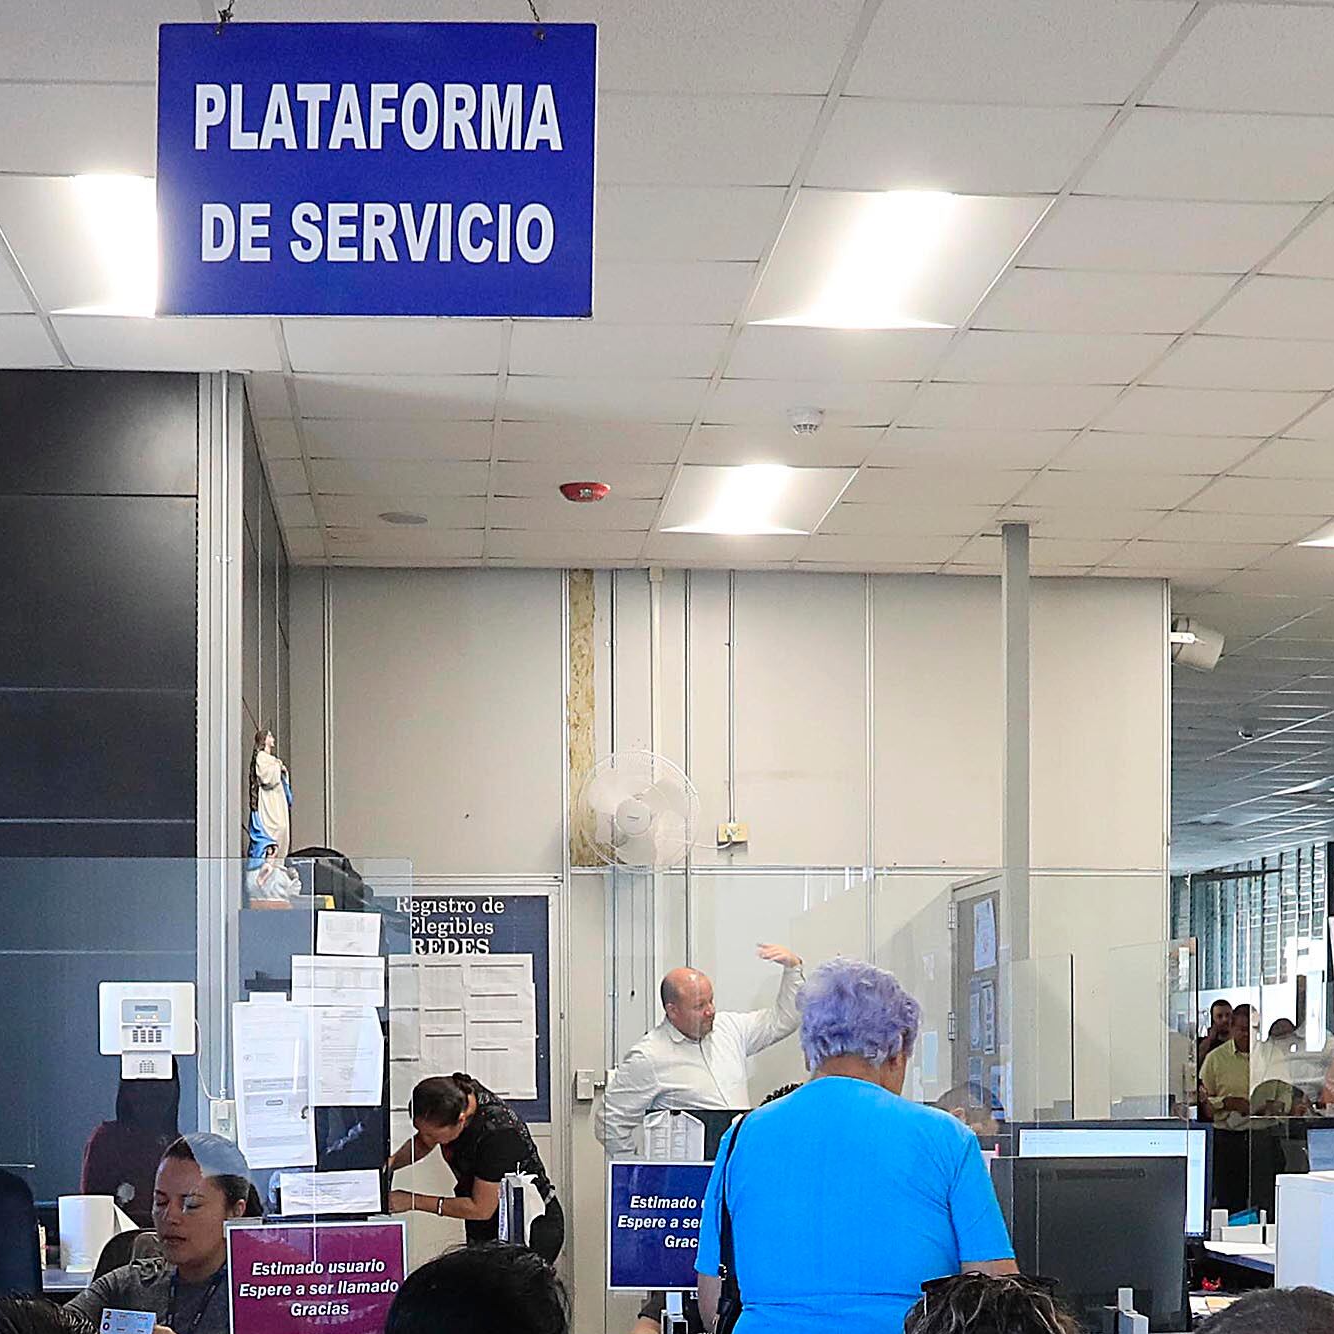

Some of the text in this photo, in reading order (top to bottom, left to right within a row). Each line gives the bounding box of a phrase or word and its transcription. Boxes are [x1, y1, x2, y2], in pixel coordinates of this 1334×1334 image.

[194, 83, 563, 151] PLATAFORMA
[200, 202, 555, 265] DE SERVICIO
[395, 896, 505, 917] Registro de
[411, 916, 494, 938] Elegibles
[412, 938, 490, 955] REDES
[630, 1195, 697, 1209] Estimado
[617, 1215, 702, 1230] Espere a se
[664, 1235, 699, 1248] Grac
[252, 1258, 385, 1276] Estimado usuario
[239, 1279, 400, 1299] Espere a ser llamado
[290, 1301, 349, 1317] Gracias
